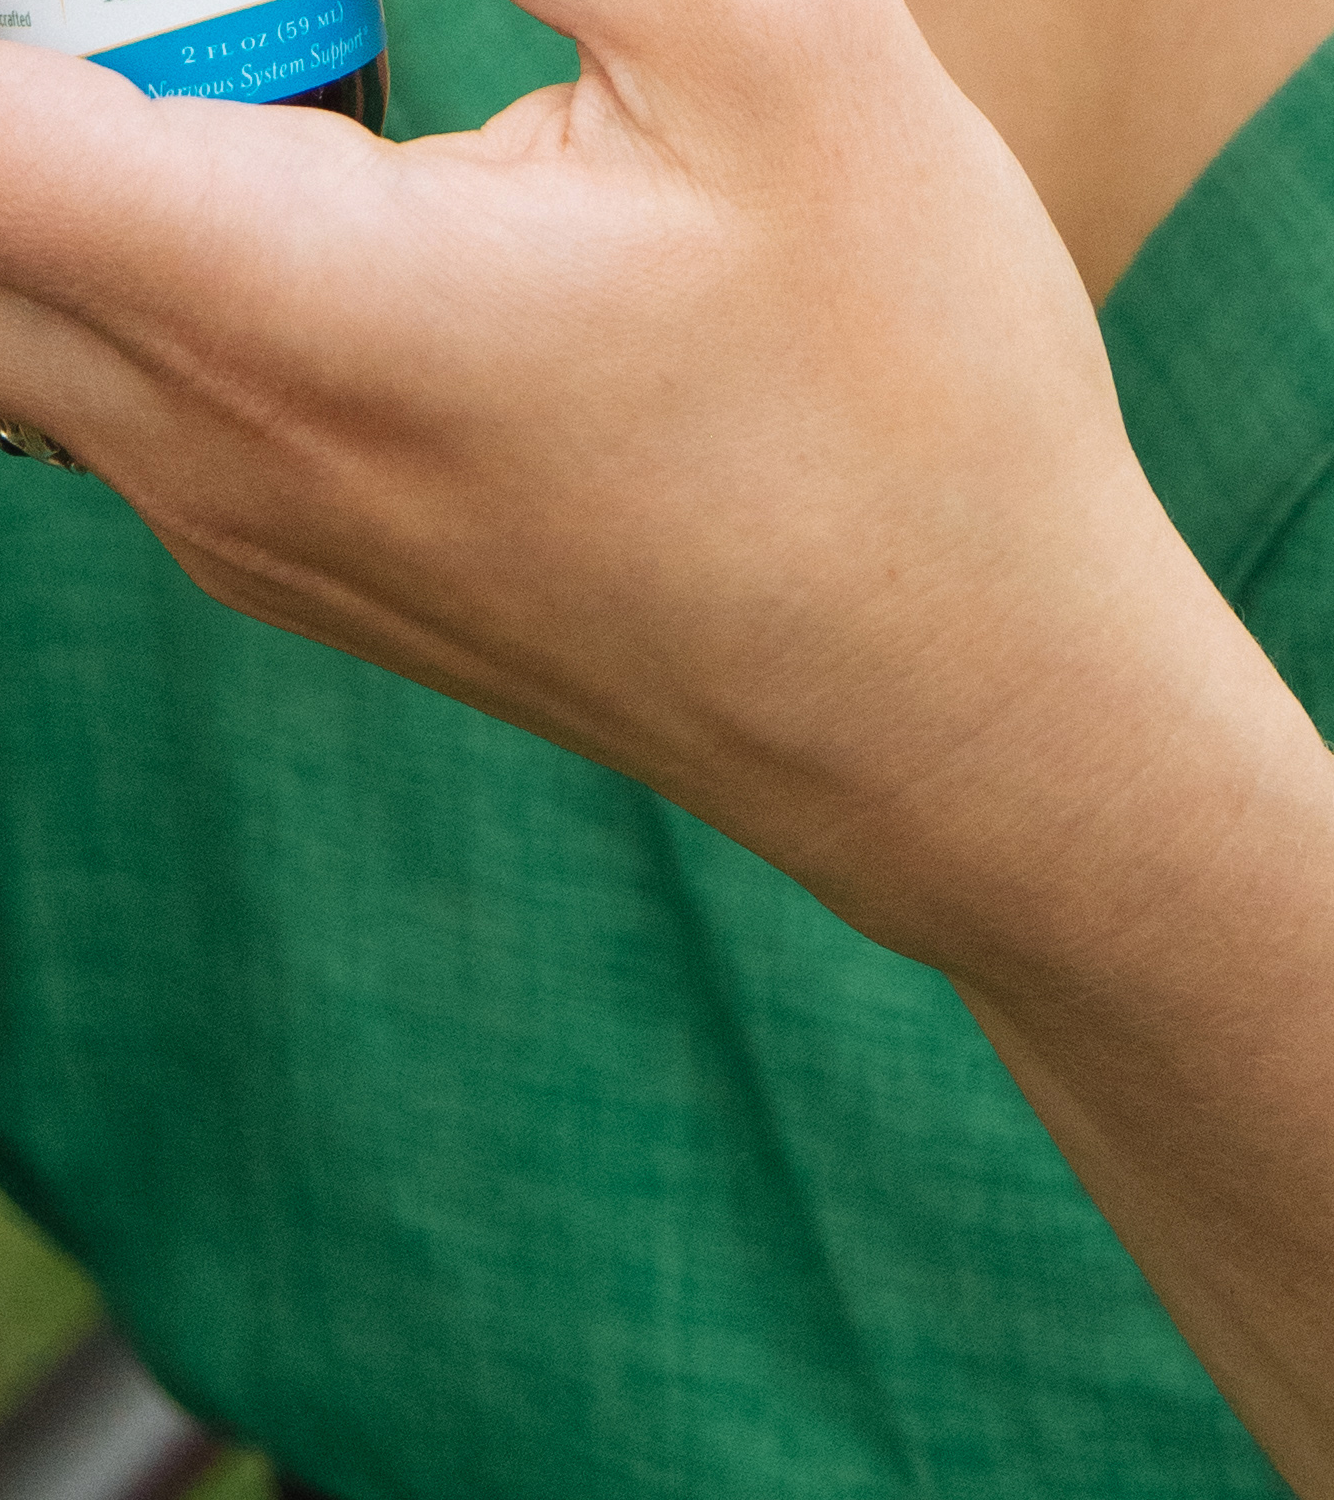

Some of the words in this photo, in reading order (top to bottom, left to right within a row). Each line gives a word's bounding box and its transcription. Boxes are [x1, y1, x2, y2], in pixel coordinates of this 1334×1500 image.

[181, 45, 196, 65] 2
[276, 16, 310, 44] (59
[240, 57, 305, 98] System
